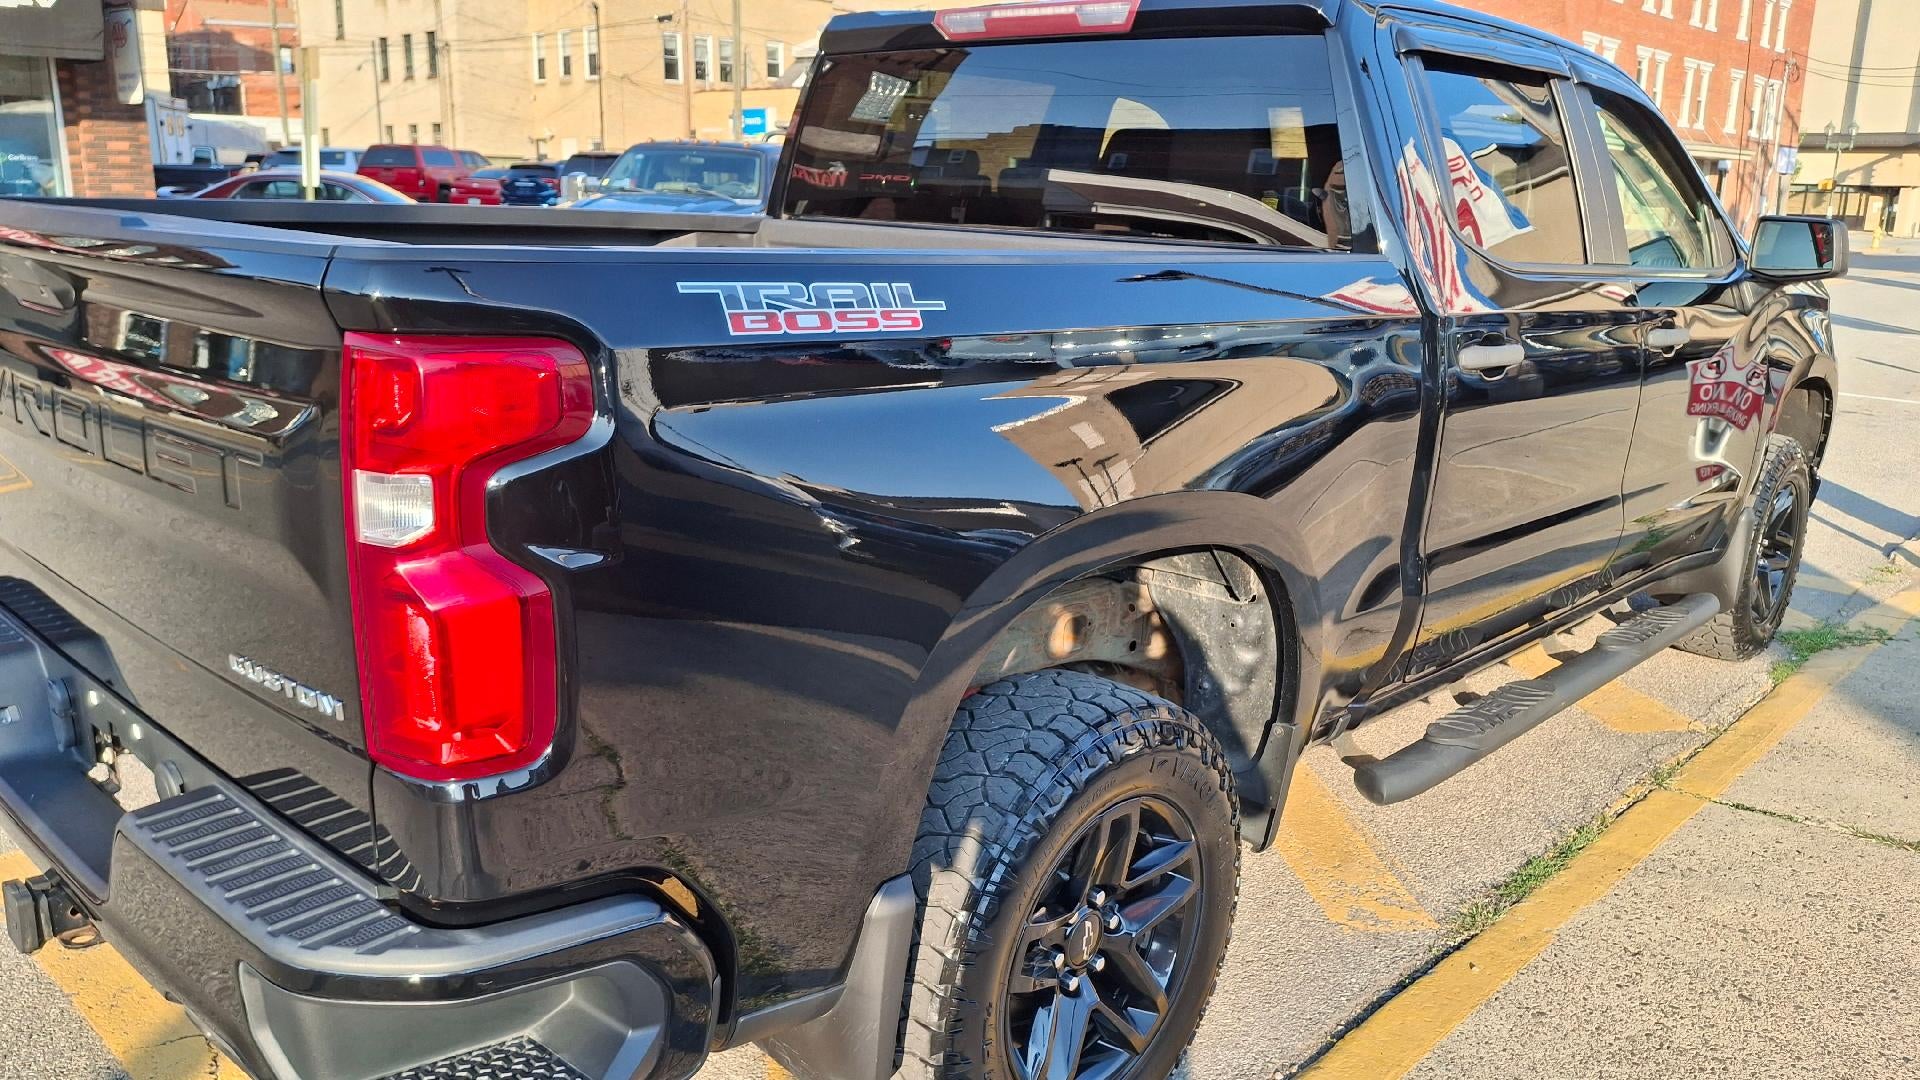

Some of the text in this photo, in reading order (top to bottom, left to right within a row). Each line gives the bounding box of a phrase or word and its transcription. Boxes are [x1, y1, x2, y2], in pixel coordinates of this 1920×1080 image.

[676, 282, 946, 310] TRAIL
[727, 308, 923, 336] BOSS
[228, 654, 345, 721] CUSTOM
